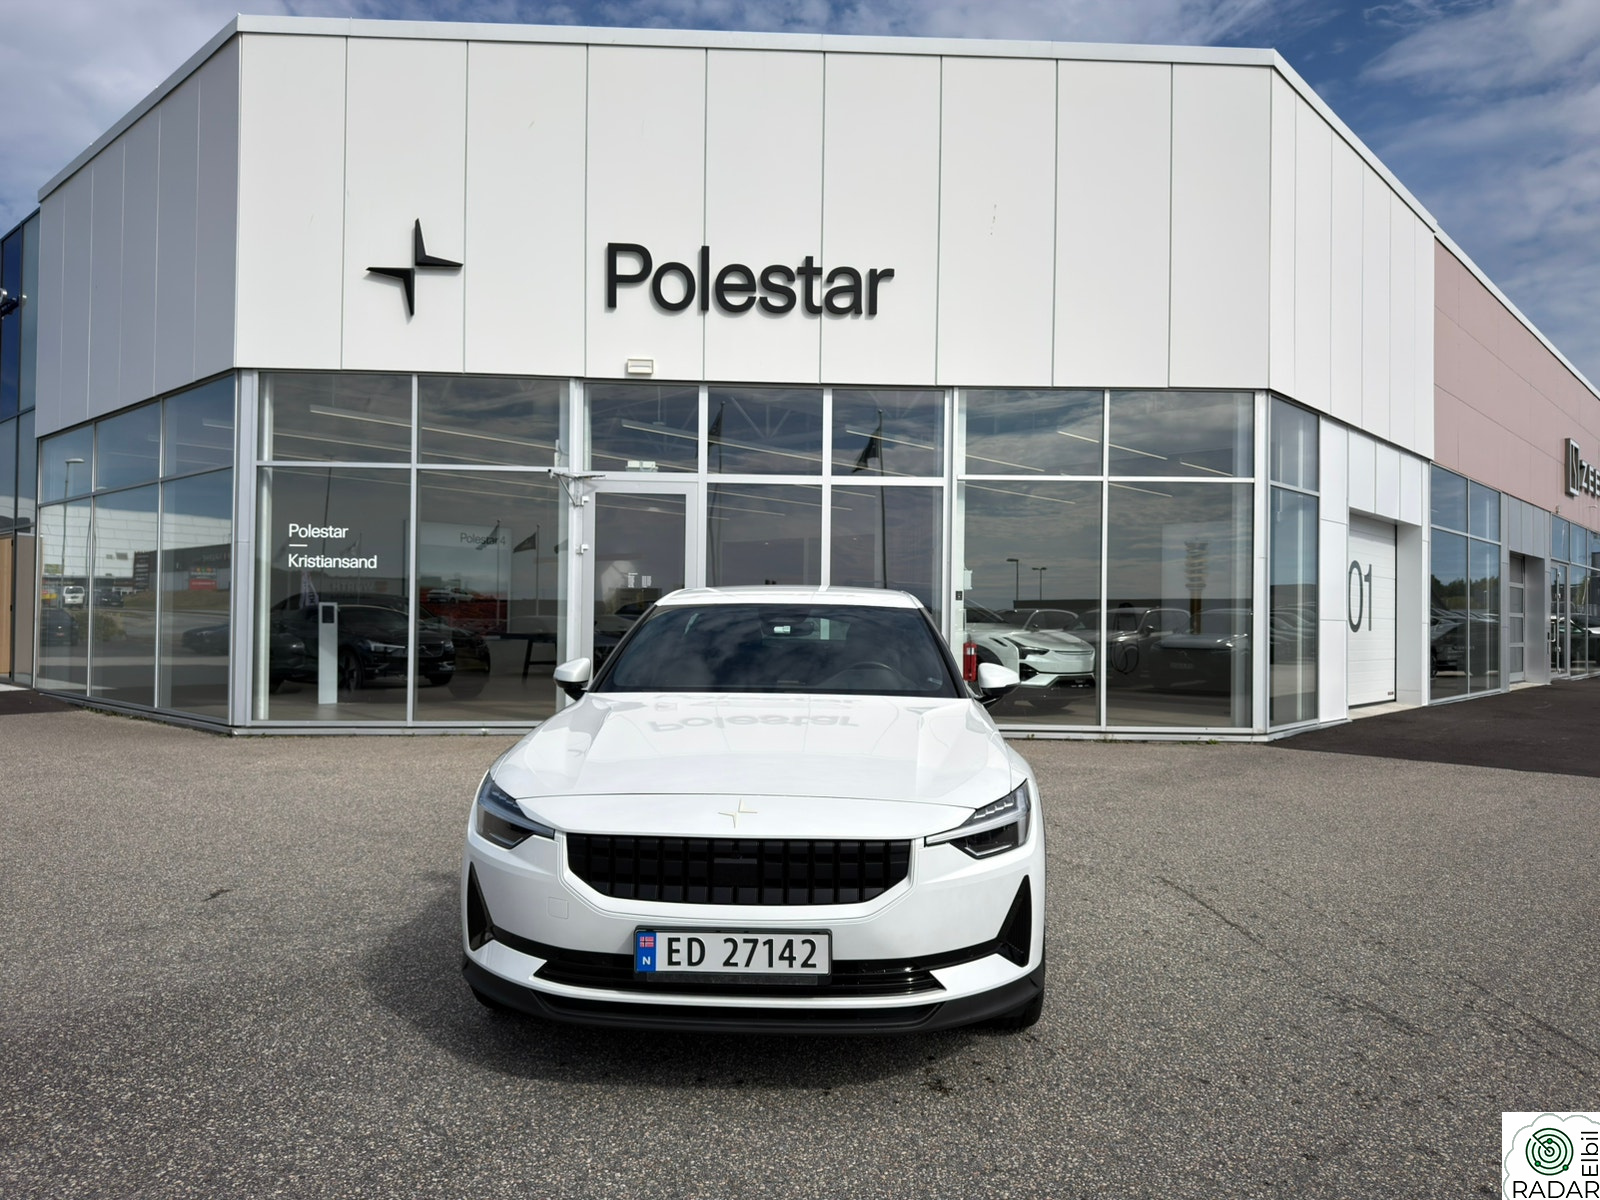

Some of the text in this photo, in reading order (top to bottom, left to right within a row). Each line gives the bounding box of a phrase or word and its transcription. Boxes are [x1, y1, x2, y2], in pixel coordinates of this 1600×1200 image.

[607, 243, 894, 316] Polestar
[288, 523, 349, 538] Polestar
[460, 532, 498, 545] Polestar
[288, 553, 378, 569] Kristiansand
[1348, 560, 1372, 632] 01
[667, 937, 817, 968] ED 27142
[642, 956, 651, 966] N
